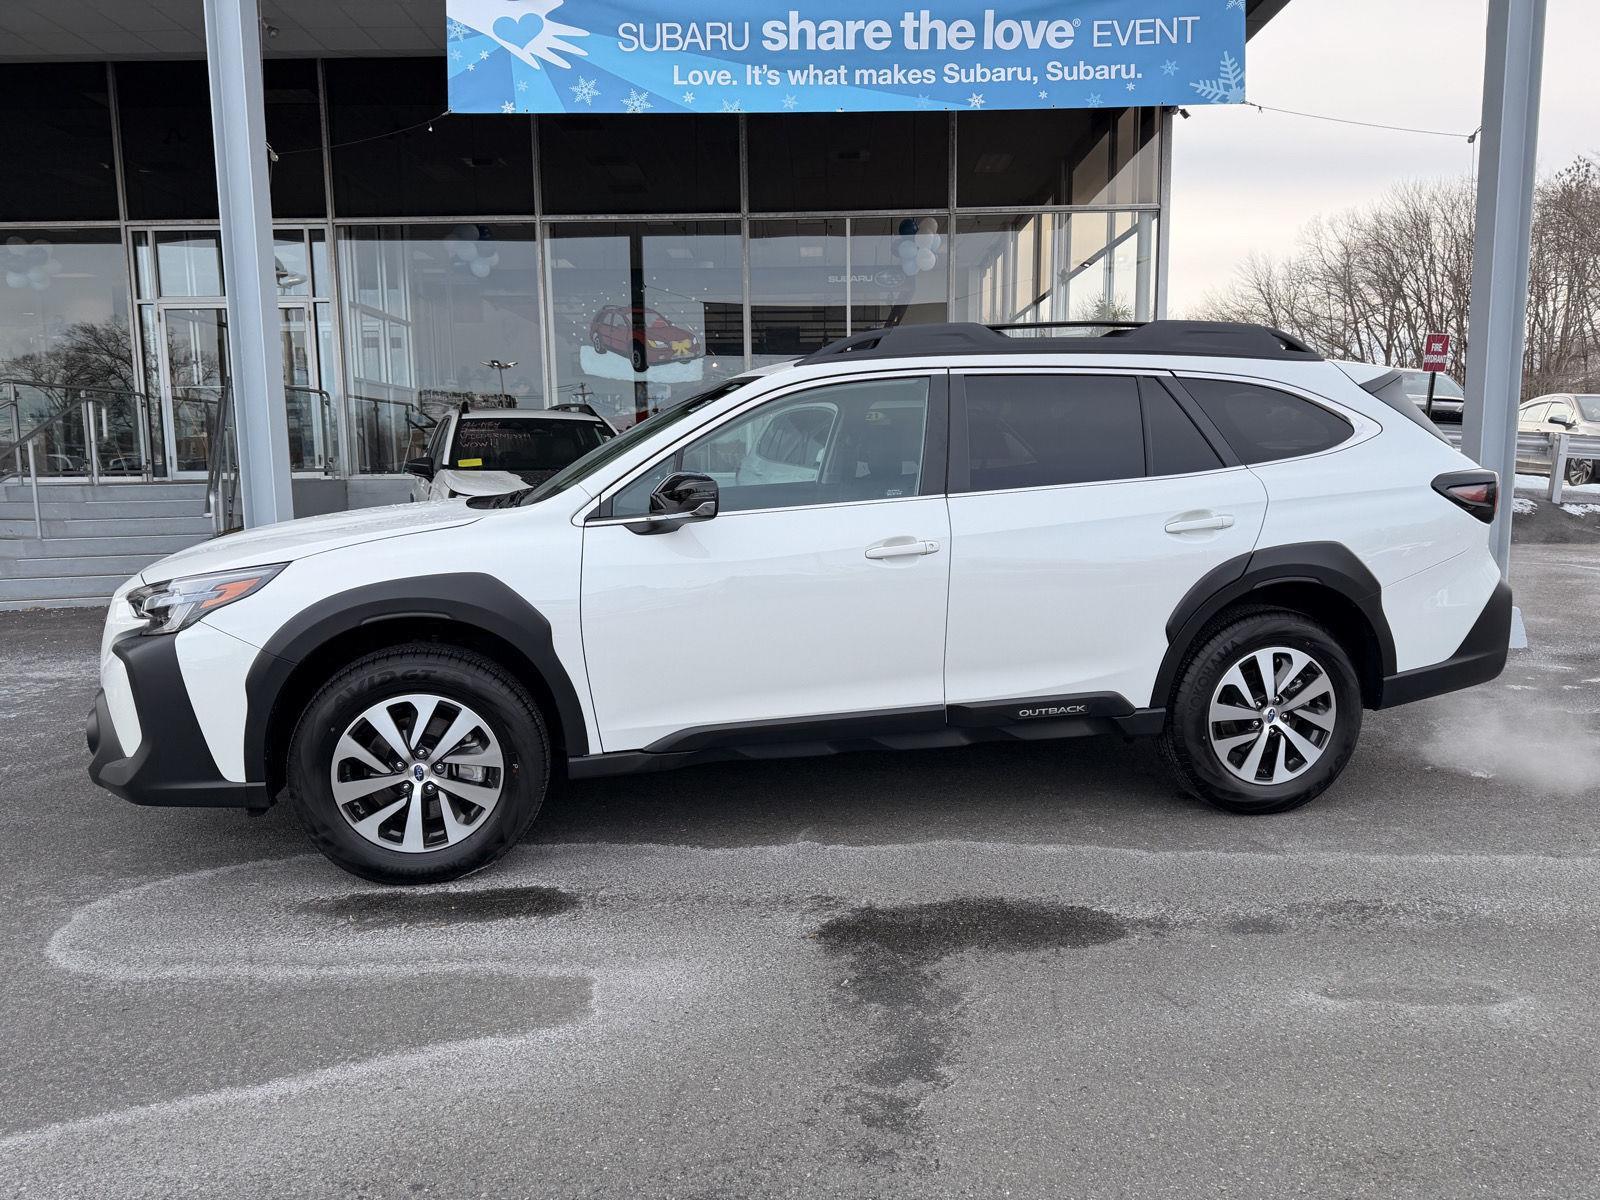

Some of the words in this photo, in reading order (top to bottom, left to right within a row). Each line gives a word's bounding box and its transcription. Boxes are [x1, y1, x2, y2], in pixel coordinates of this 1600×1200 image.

[617, 22, 749, 51] SUBARU
[761, 10, 892, 51] share
[900, 9, 976, 50] the
[1093, 16, 1201, 48] EVENT
[673, 65, 738, 86] Love.
[787, 64, 848, 86] what
[855, 63, 936, 86] makes
[943, 61, 1039, 85] Subaru,
[1046, 60, 1143, 82] Subaru.
[1018, 704, 1087, 717] OUTBACK
